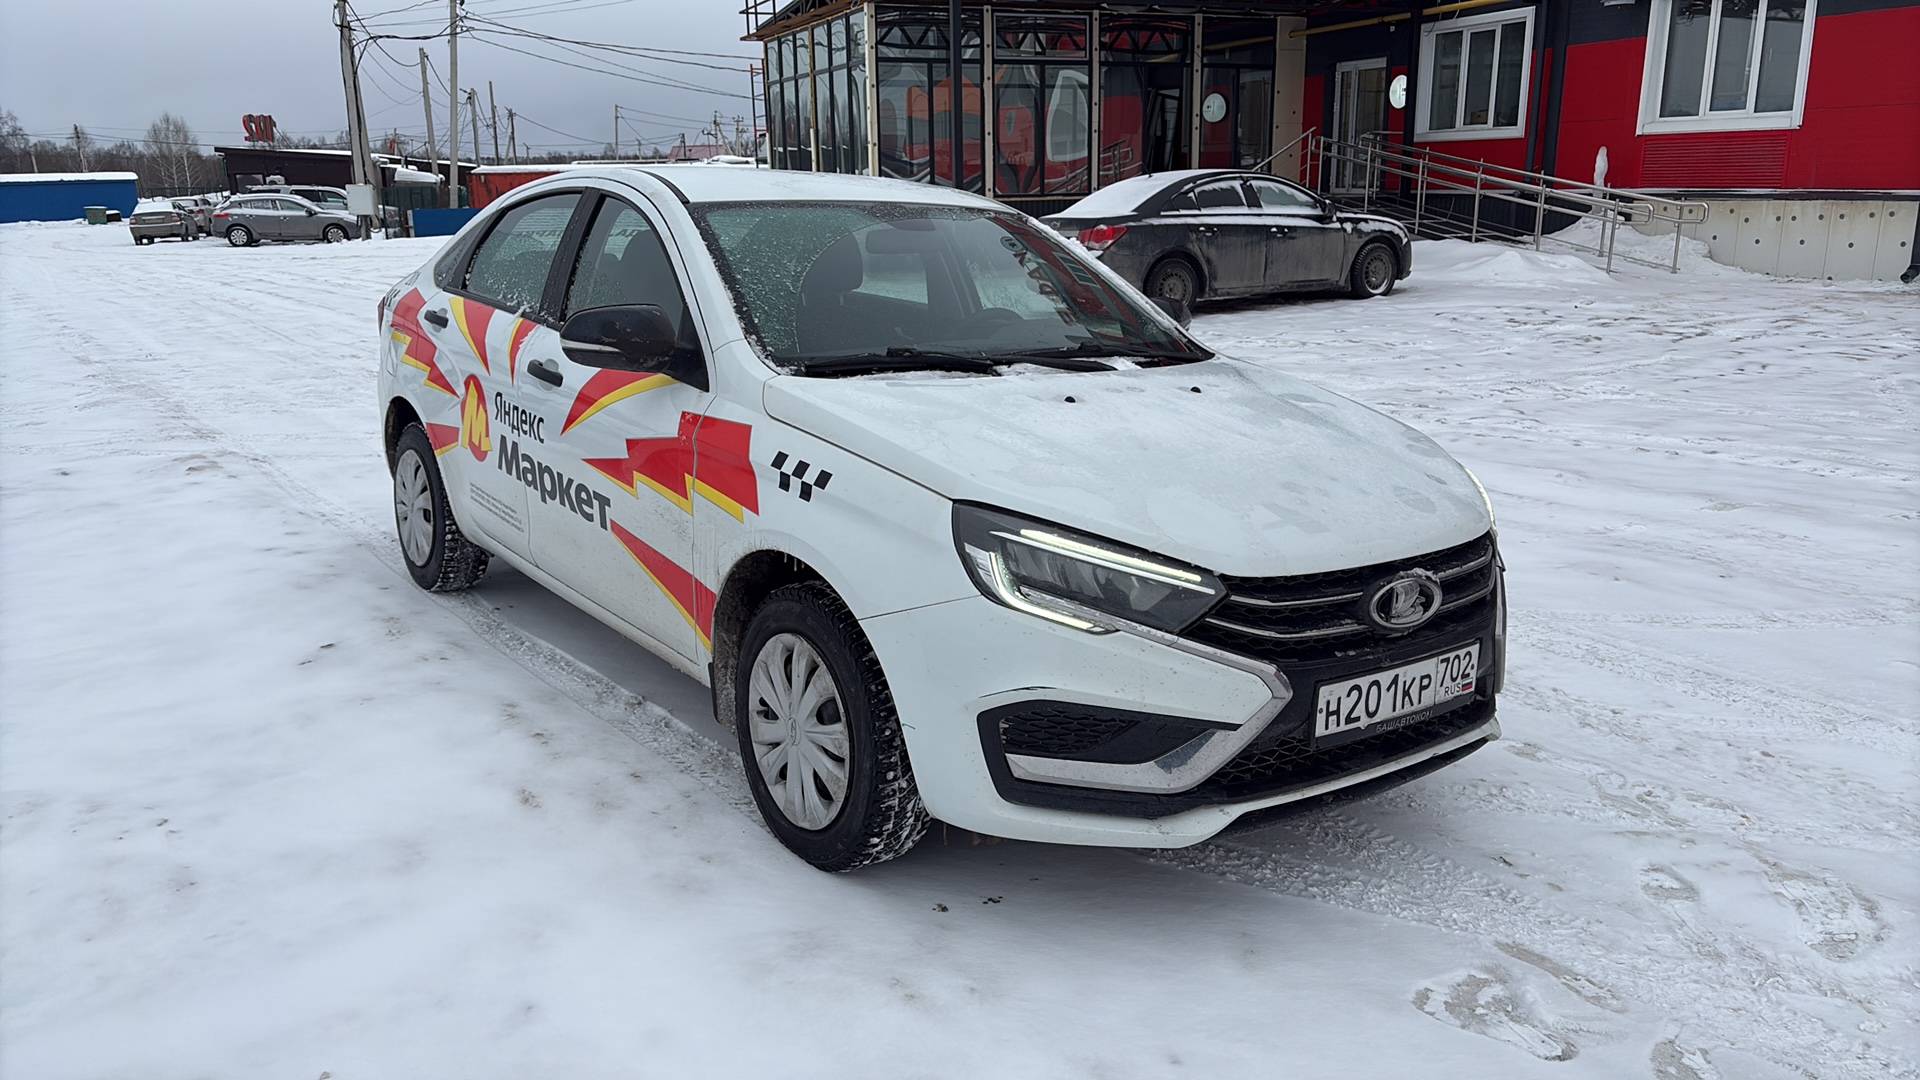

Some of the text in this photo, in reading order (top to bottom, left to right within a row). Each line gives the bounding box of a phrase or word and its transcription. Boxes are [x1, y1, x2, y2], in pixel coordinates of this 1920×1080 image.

[494, 391, 545, 444] Яндекс
[497, 434, 612, 531] Маркет
[1324, 650, 1473, 731] Н201КР 702
[1443, 685, 1462, 697] RUS
[1375, 710, 1433, 734] БАШАВТОКОМ
